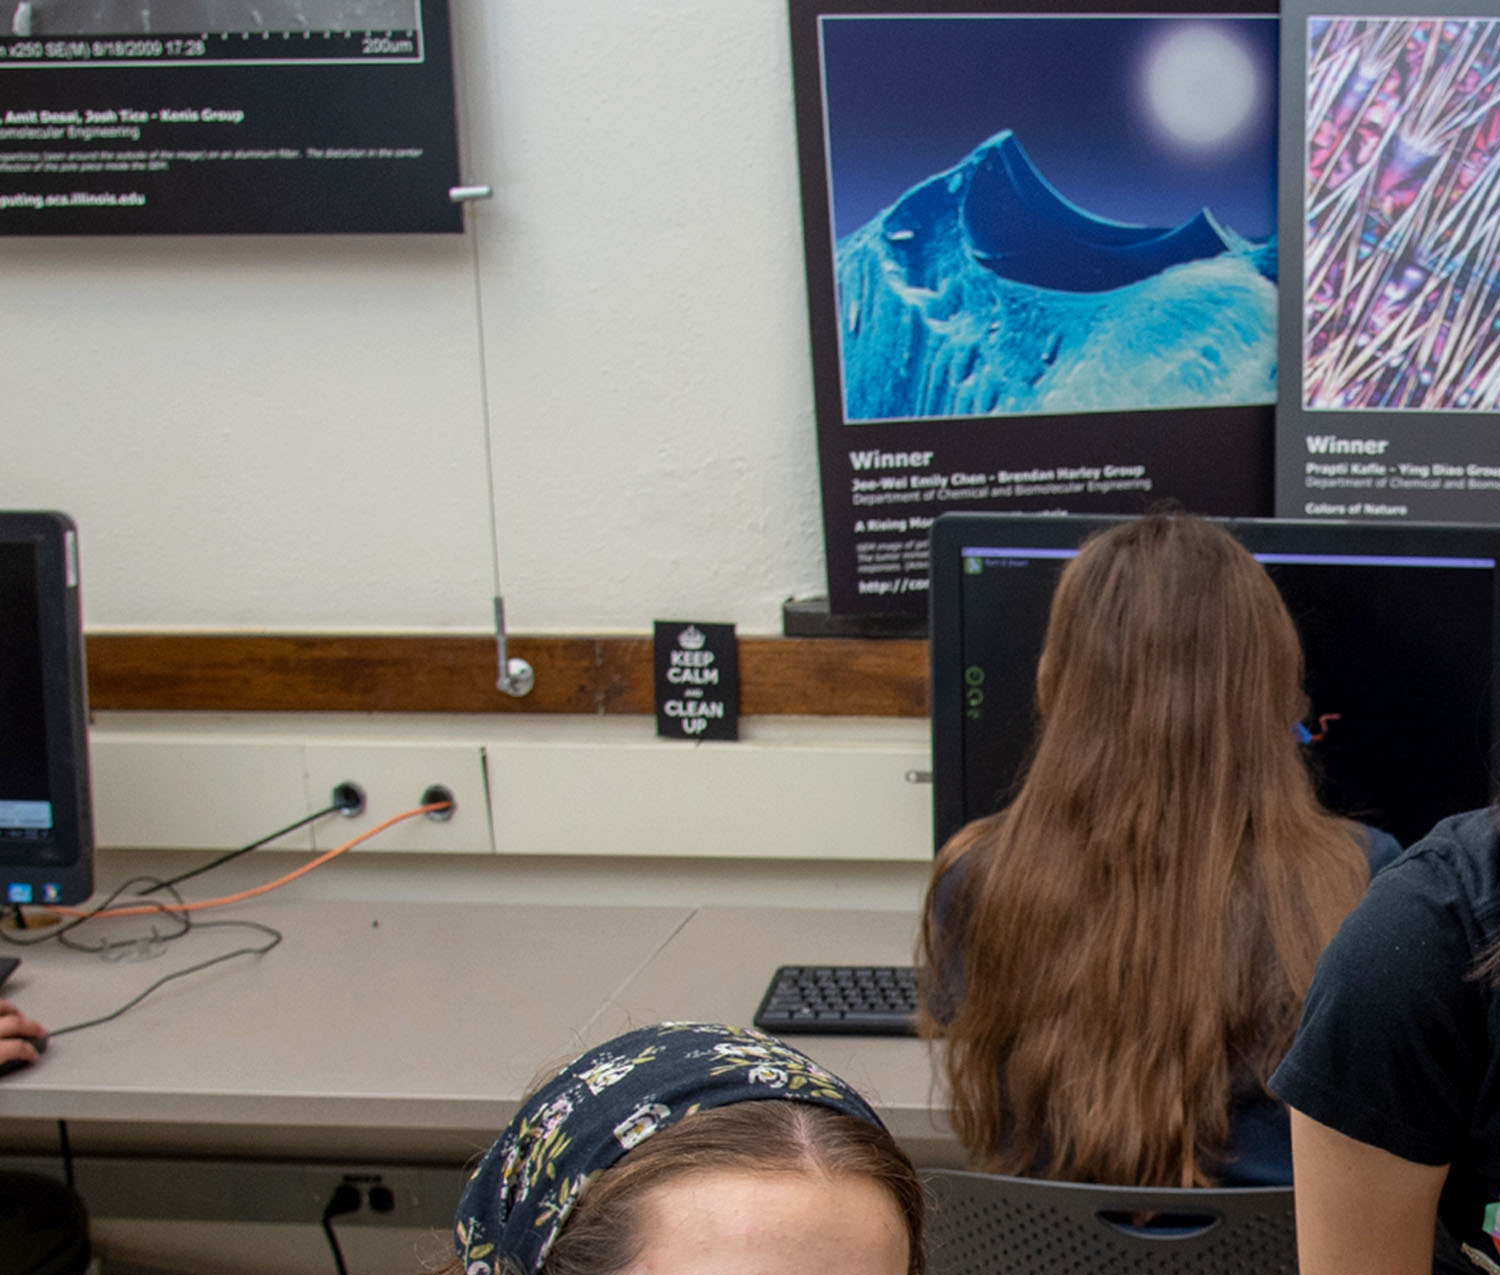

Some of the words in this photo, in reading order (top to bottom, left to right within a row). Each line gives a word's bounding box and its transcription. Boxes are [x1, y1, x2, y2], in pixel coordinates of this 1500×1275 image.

[201, 107, 244, 125] Group
[66, 124, 140, 141] Engineering
[1306, 434, 1389, 455] Winner
[849, 449, 934, 471] Winner
[910, 473, 949, 489] Emily
[1103, 465, 1145, 479] Group
[1443, 478, 1465, 490] and
[1347, 502, 1362, 515] of
[670, 650, 715, 667] KEEP
[666, 667, 719, 685] CALM
[664, 700, 724, 718] CLEAN
[681, 718, 707, 734] UP
